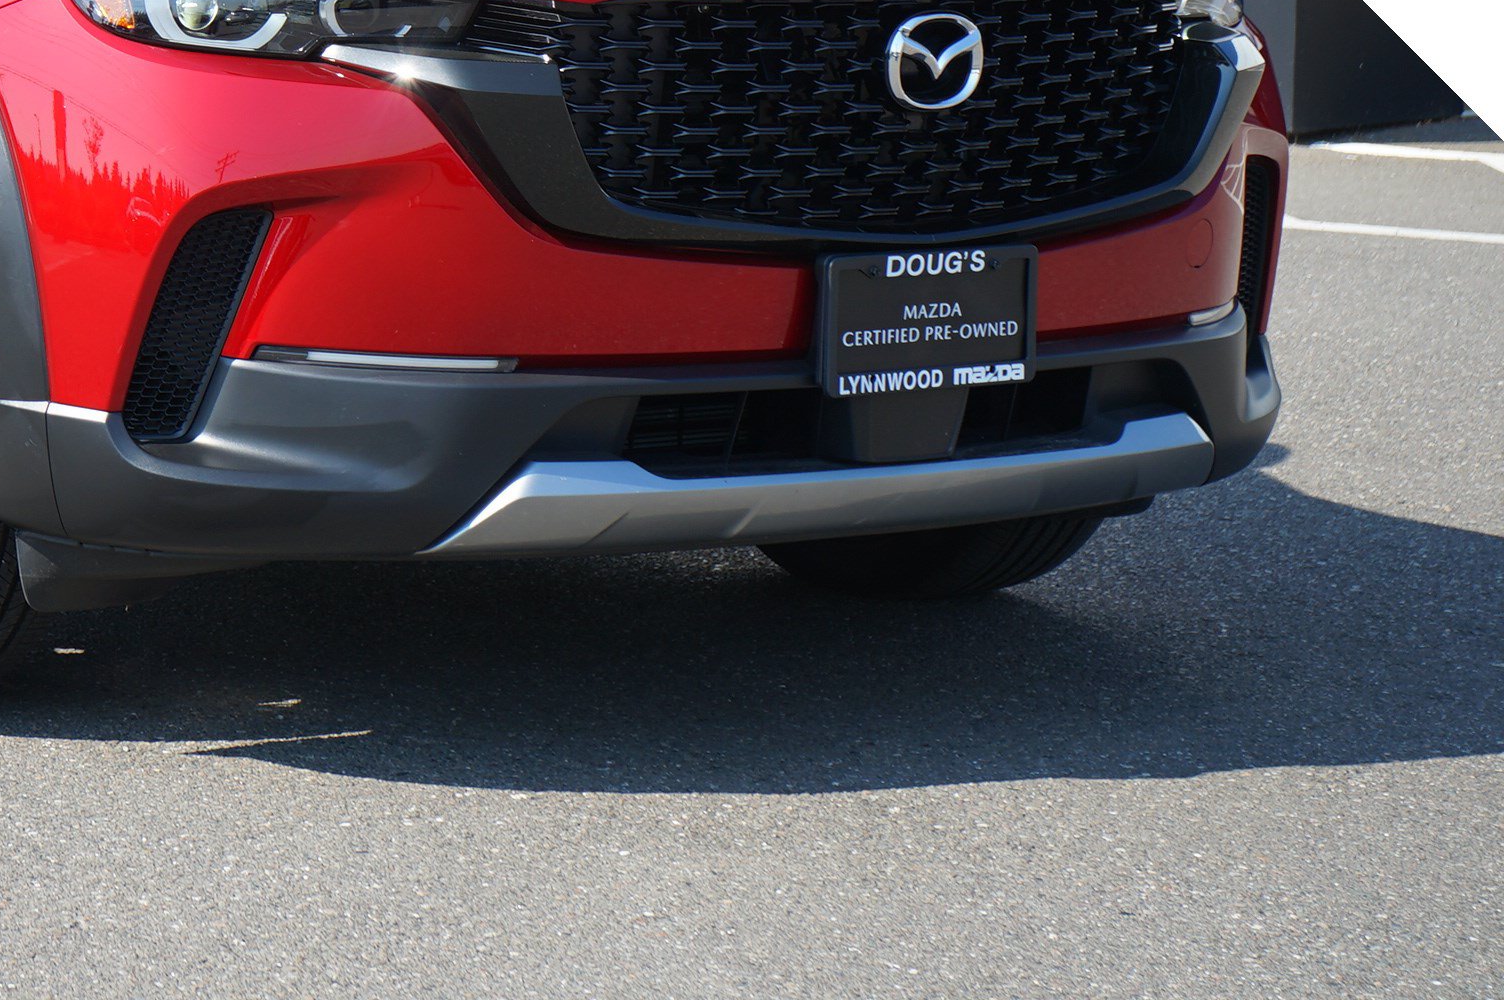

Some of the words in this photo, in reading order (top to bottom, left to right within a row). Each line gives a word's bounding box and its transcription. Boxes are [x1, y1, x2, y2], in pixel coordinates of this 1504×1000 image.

[886, 250, 986, 278] DOUG'S
[903, 302, 962, 320] MAZDA
[842, 327, 920, 347] CERTIFIED
[925, 320, 1019, 341] PRE-OWNED
[839, 369, 943, 396] LYNNWOOD
